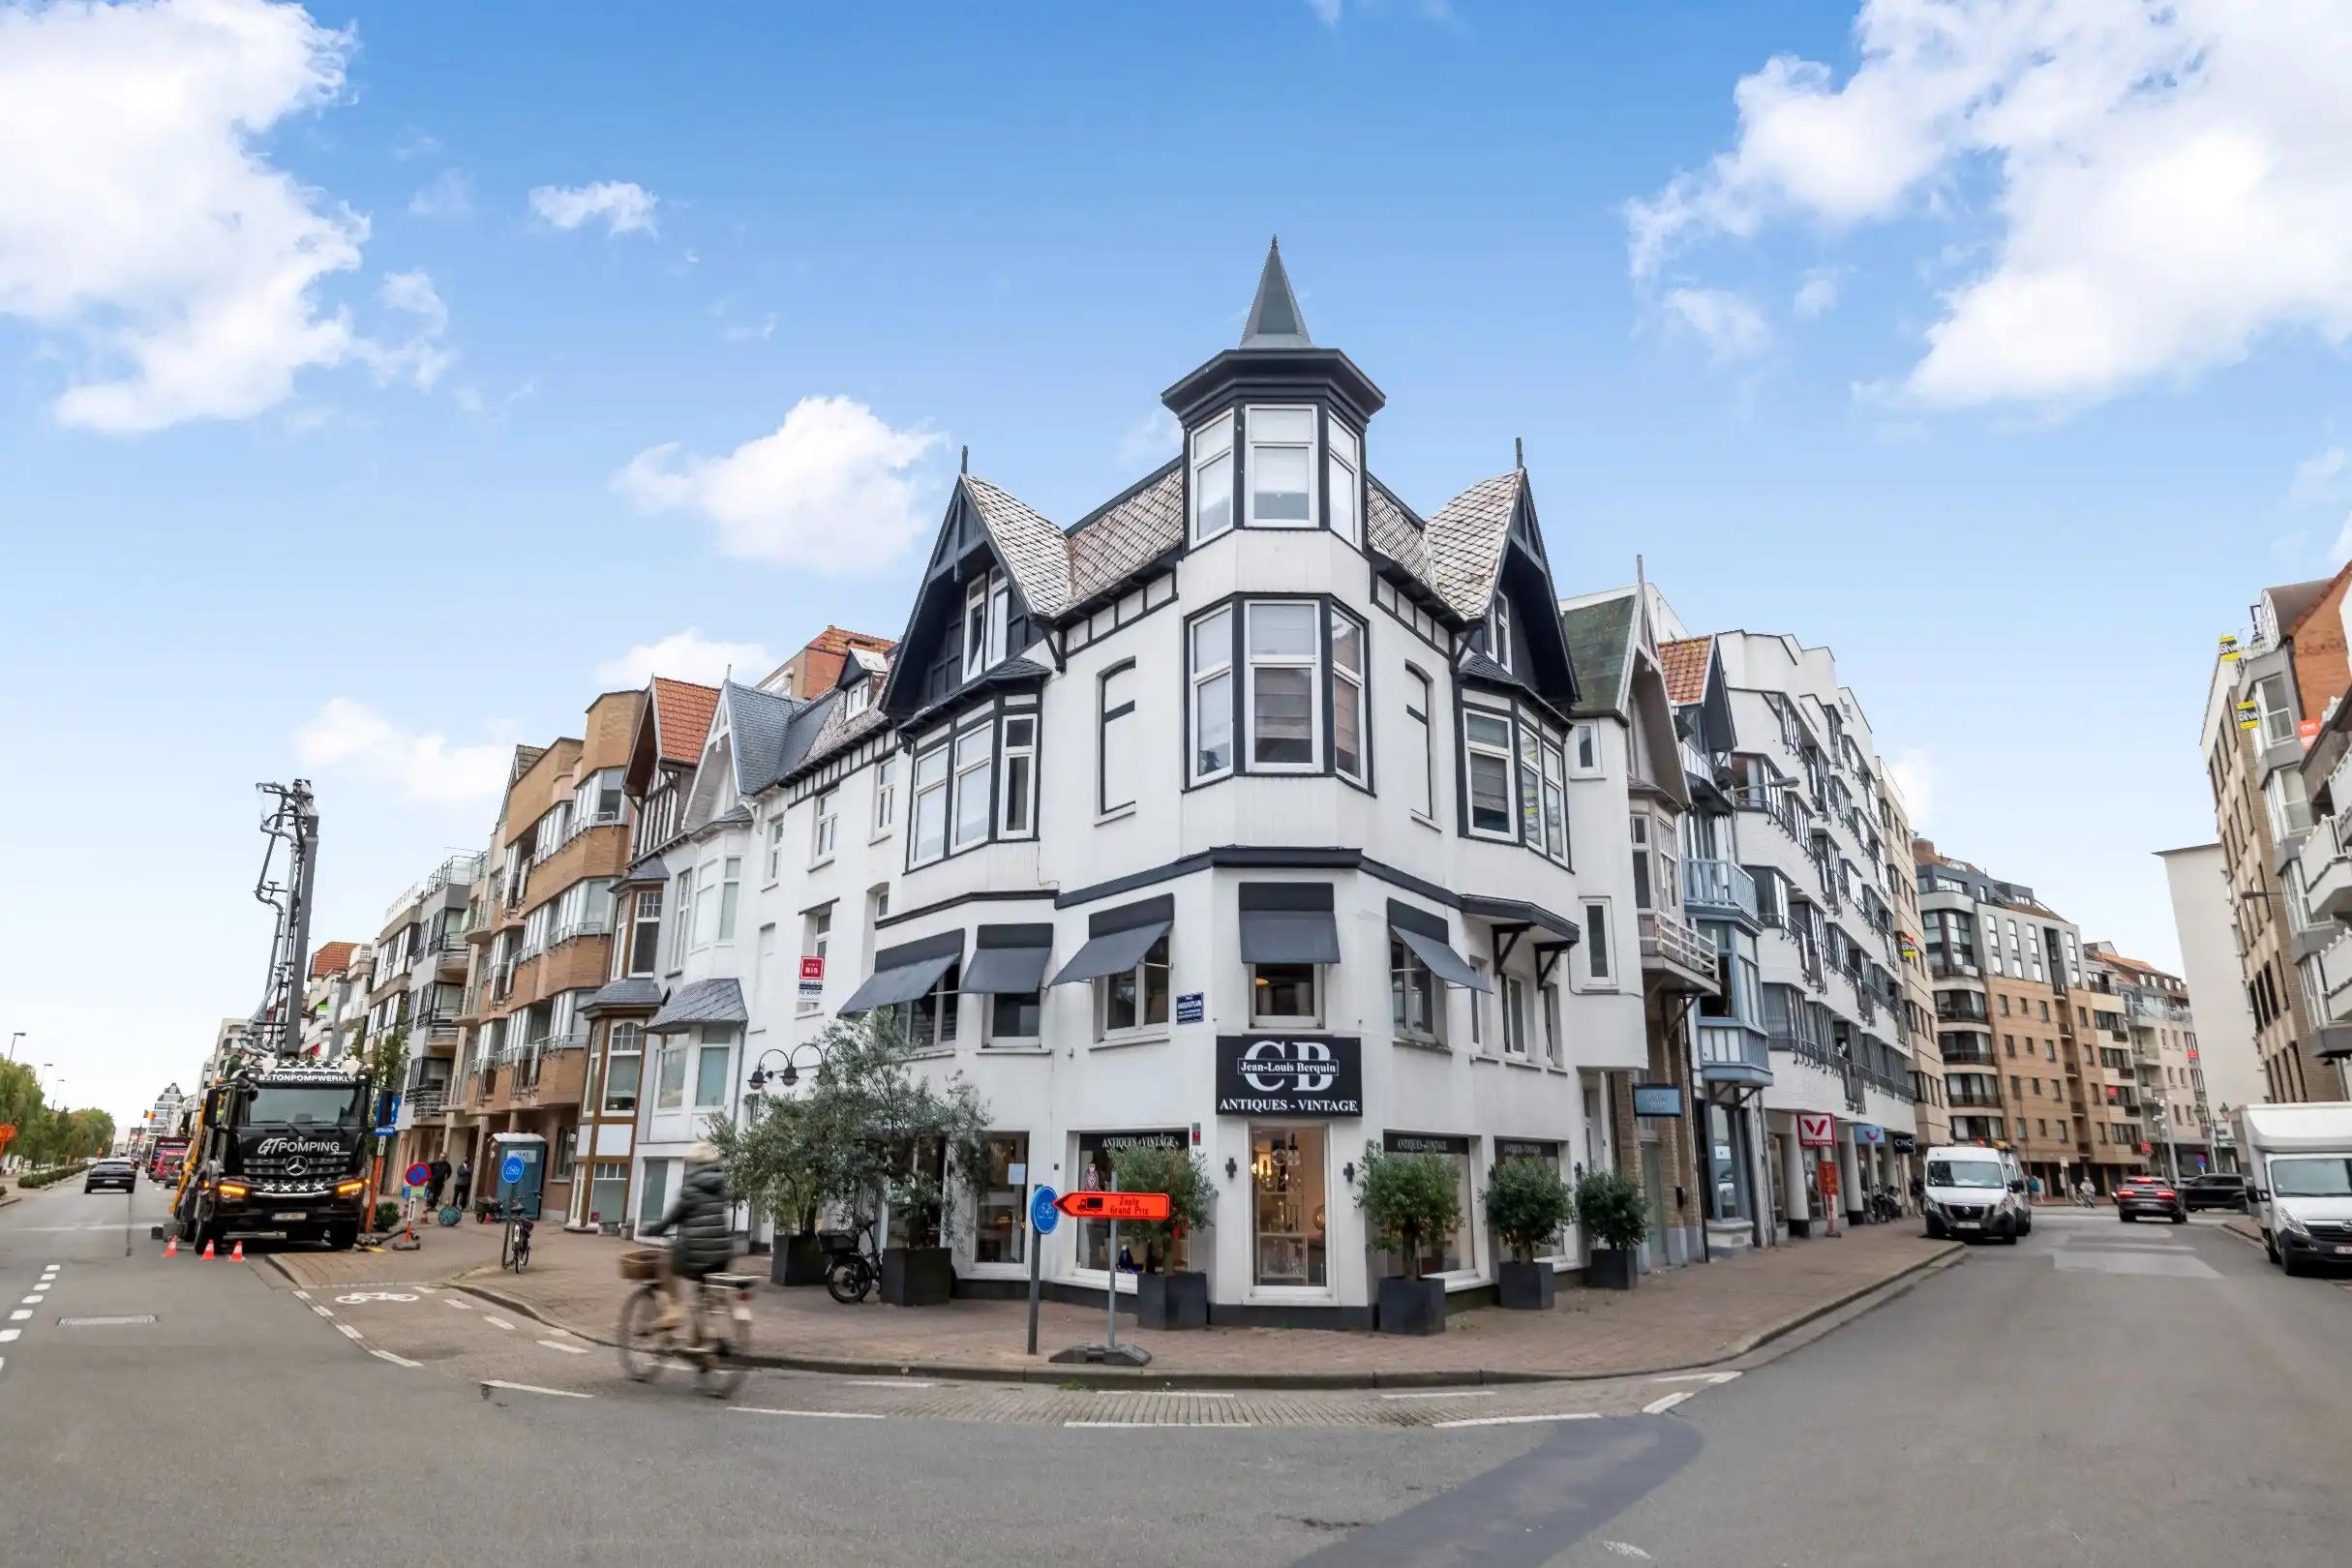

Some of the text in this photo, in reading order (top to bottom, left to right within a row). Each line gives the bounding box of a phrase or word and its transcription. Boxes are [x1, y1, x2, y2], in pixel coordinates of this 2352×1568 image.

[1241, 1062, 1337, 1074] Jean-Louis Berquin
[1220, 1099, 1288, 1112] ANTIQUES
[1297, 1100, 1358, 1112] VINTAGE
[1102, 1136, 1137, 1150] ANTIQUES
[1141, 1135, 1175, 1149] VINTAGE
[1119, 1196, 1139, 1206] Zoute
[1110, 1206, 1149, 1215] Grand Prix
